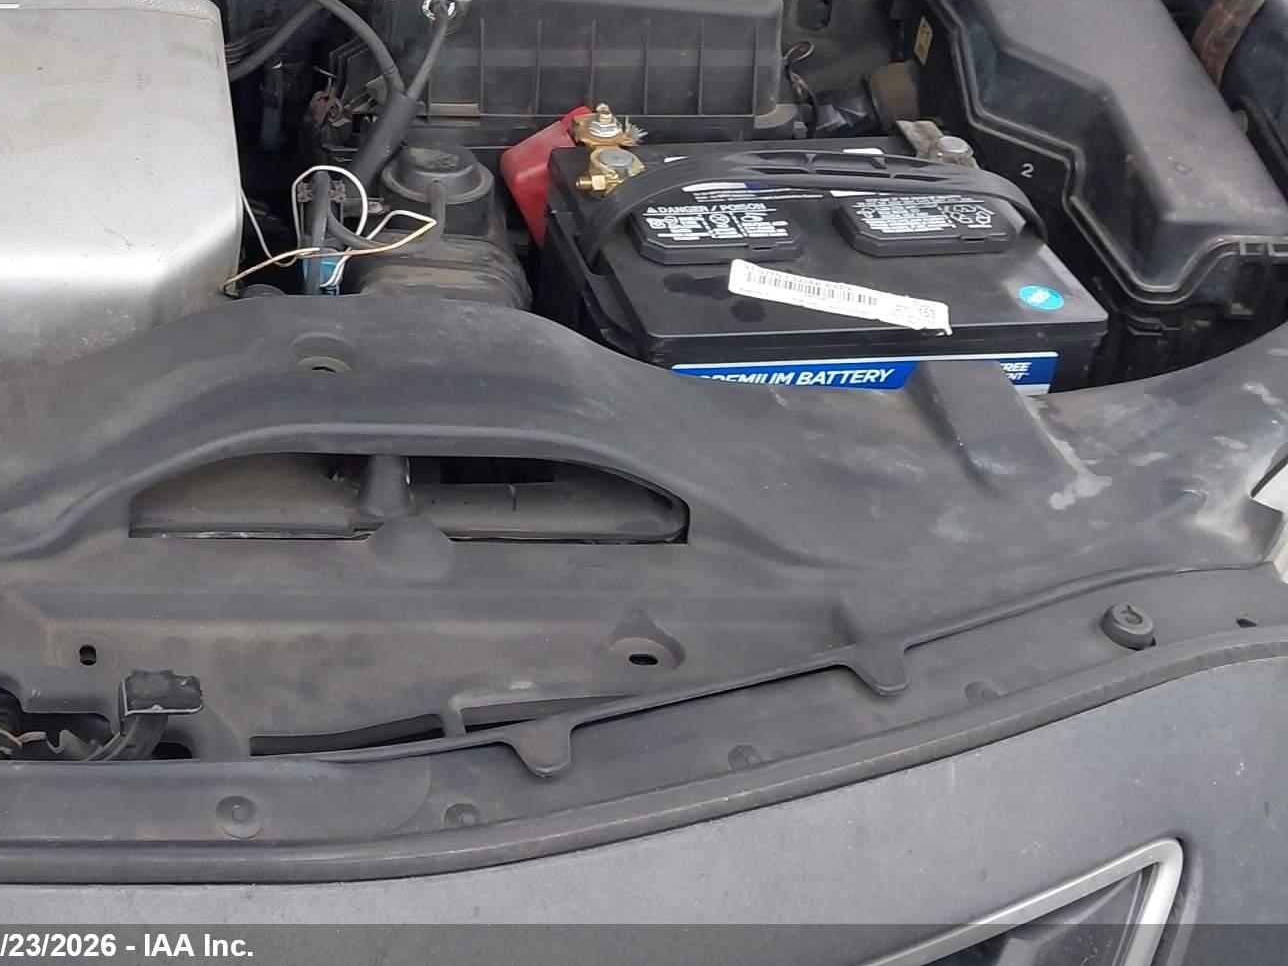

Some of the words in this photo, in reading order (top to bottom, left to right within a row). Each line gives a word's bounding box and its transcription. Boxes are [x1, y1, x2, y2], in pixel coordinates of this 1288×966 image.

[1020, 163, 1035, 178] 2
[656, 205, 709, 214] DANGER
[719, 202, 766, 211] POISON
[699, 372, 796, 385] EMIUM
[795, 368, 896, 385] BATTERY
